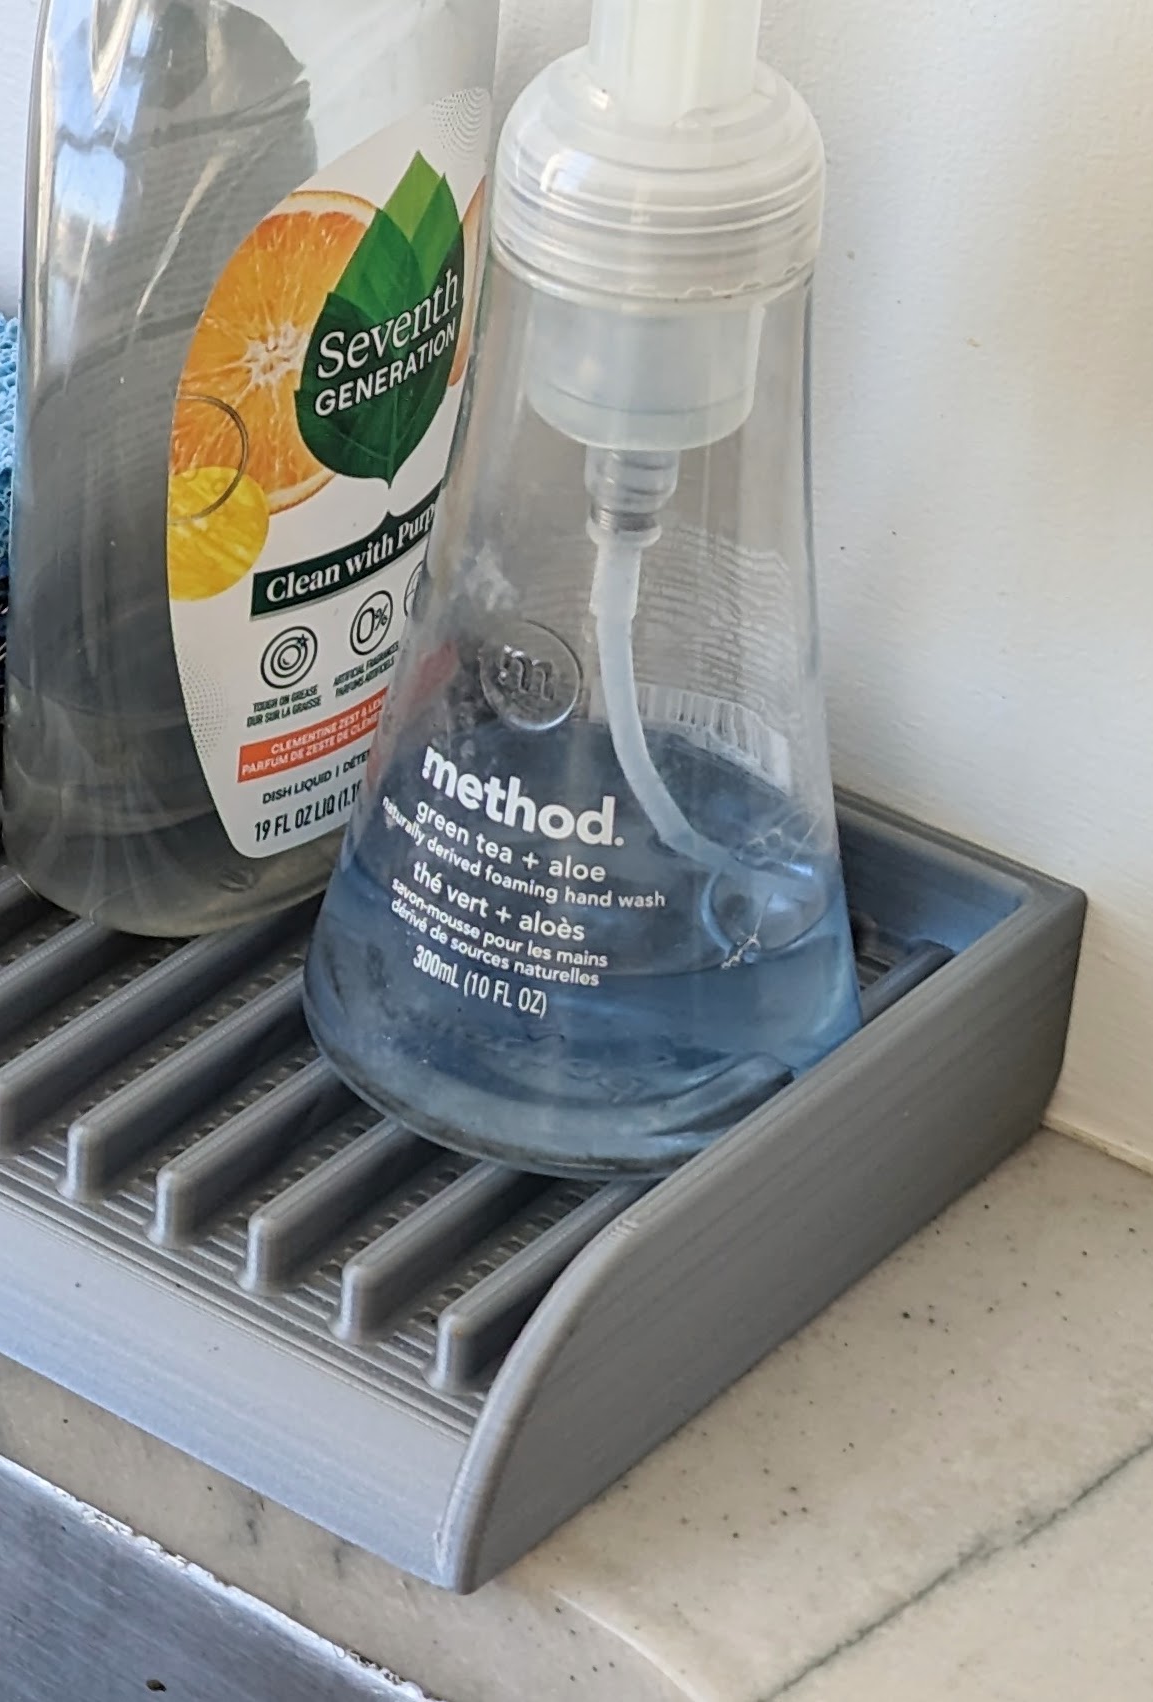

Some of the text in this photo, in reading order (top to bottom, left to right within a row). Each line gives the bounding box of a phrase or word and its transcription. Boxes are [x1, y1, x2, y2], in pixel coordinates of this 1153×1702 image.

[318, 268, 459, 379] Seventh
[315, 317, 456, 417] GENERATION
[265, 503, 437, 602] Clean with Purp
[264, 709, 280, 723] SUR
[281, 705, 291, 719] LA
[291, 684, 319, 703] GREASE
[242, 753, 288, 776] PARFUM
[290, 748, 305, 762] DE
[262, 785, 293, 804] DISH
[294, 770, 333, 793] LIQUID
[255, 819, 272, 842] 19
[274, 813, 292, 837] FL
[295, 804, 313, 829] OZ
[314, 794, 336, 822] LIQ
[382, 796, 666, 908] naturally derived foaming hand wash
[415, 801, 470, 846] green
[476, 833, 513, 865] tea
[548, 854, 606, 883] aloe
[391, 878, 609, 968] savon-mousse pour les mains
[413, 860, 443, 895] thé
[446, 884, 489, 919] vert
[518, 910, 586, 941] aloès
[391, 897, 600, 987] dérivé de sources naturelles
[413, 944, 548, 1020] 300mL (10 FL OZ)
